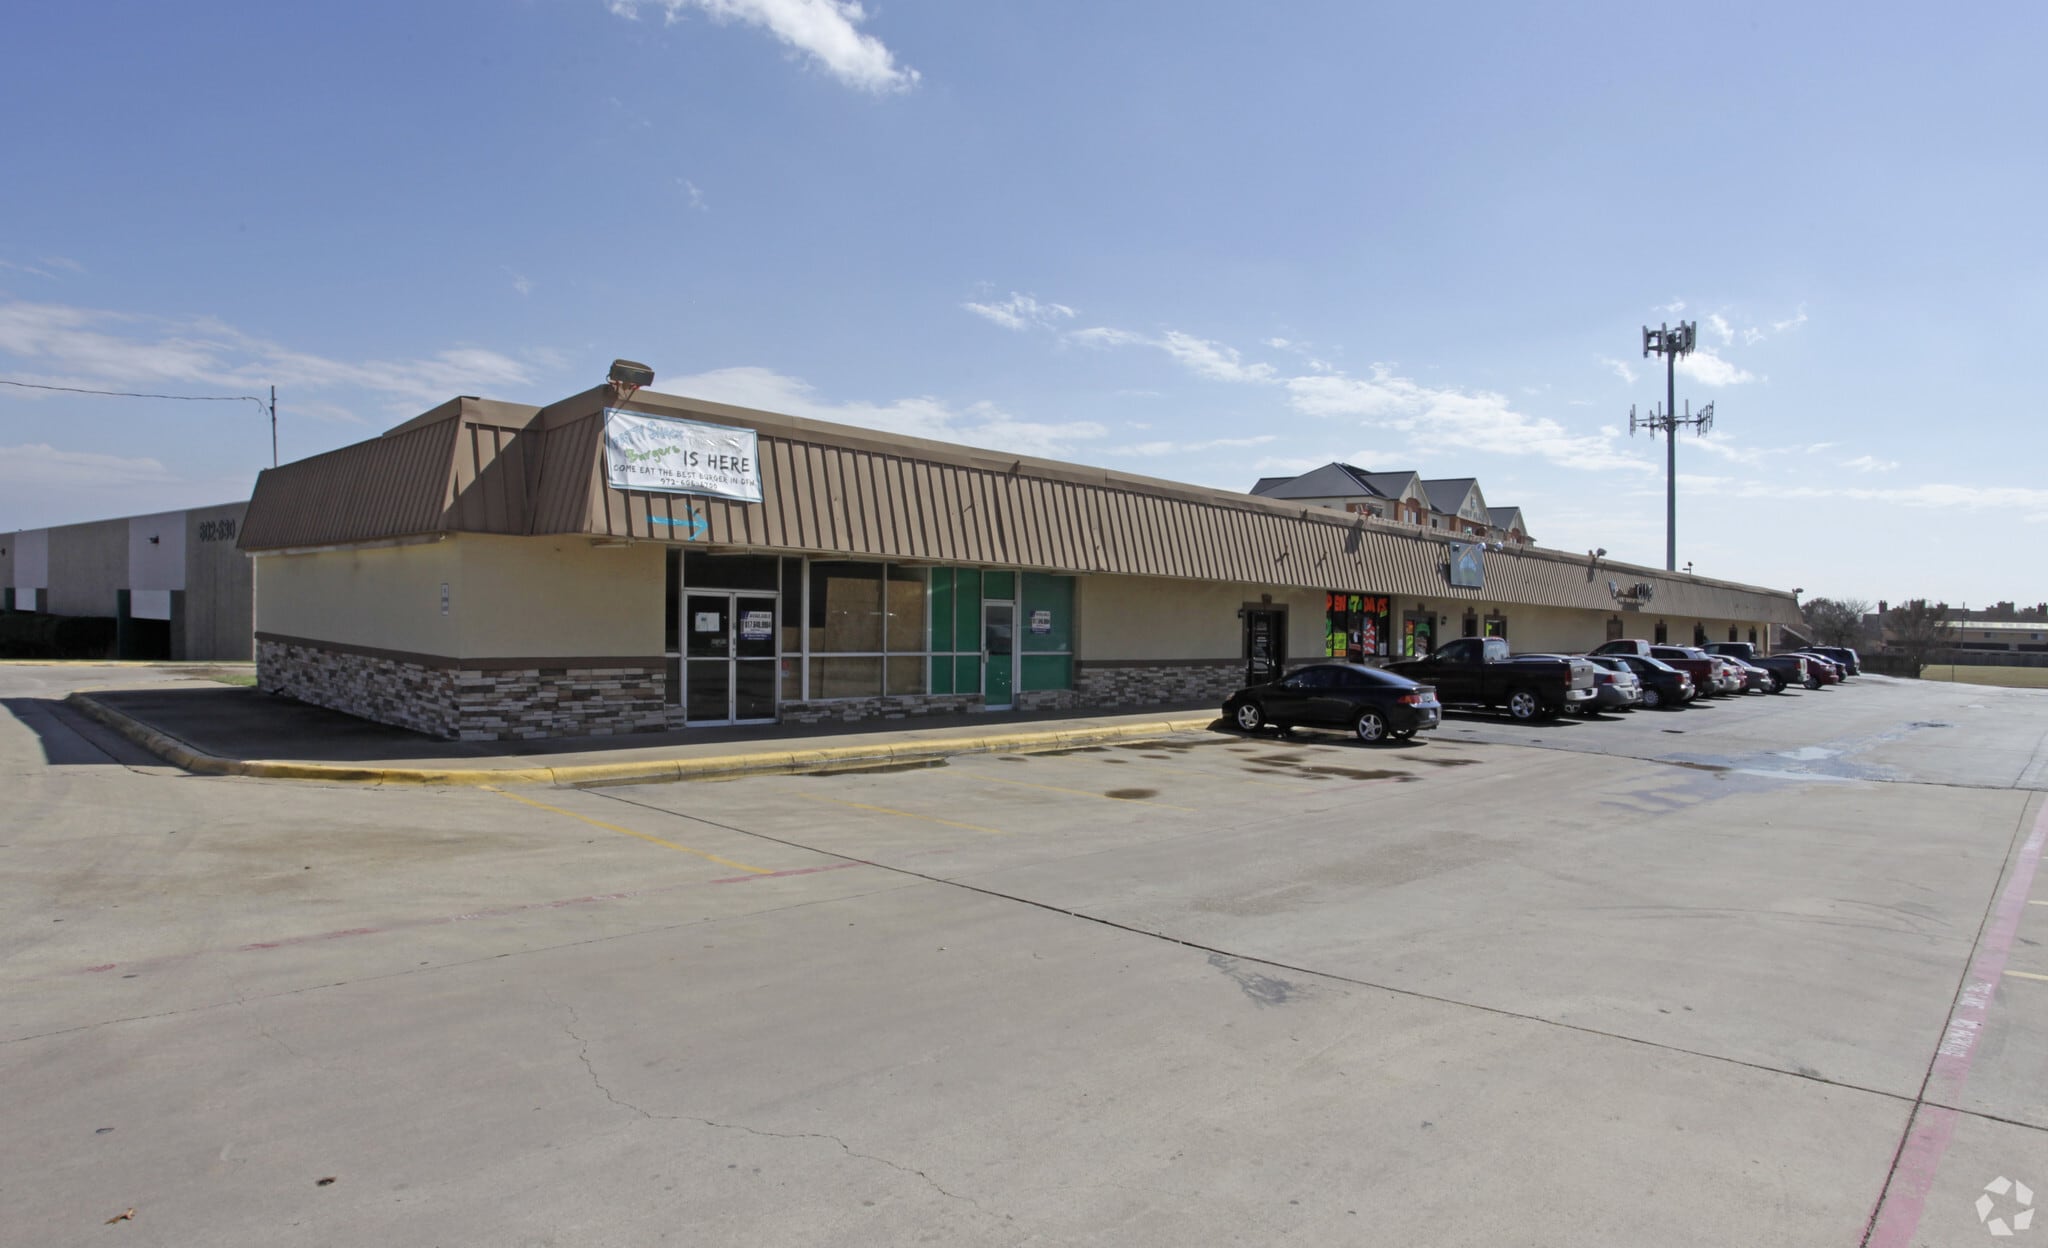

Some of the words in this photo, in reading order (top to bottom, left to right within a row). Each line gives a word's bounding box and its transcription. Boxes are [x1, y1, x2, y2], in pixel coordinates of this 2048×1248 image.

[684, 450, 698, 467] IS
[708, 453, 750, 473] HERE
[613, 464, 636, 473] COME
[640, 467, 655, 475] EAT
[659, 468, 673, 477] THE
[676, 471, 696, 480] BEST
[730, 476, 738, 485] IN
[1350, 595, 1360, 613] 7
